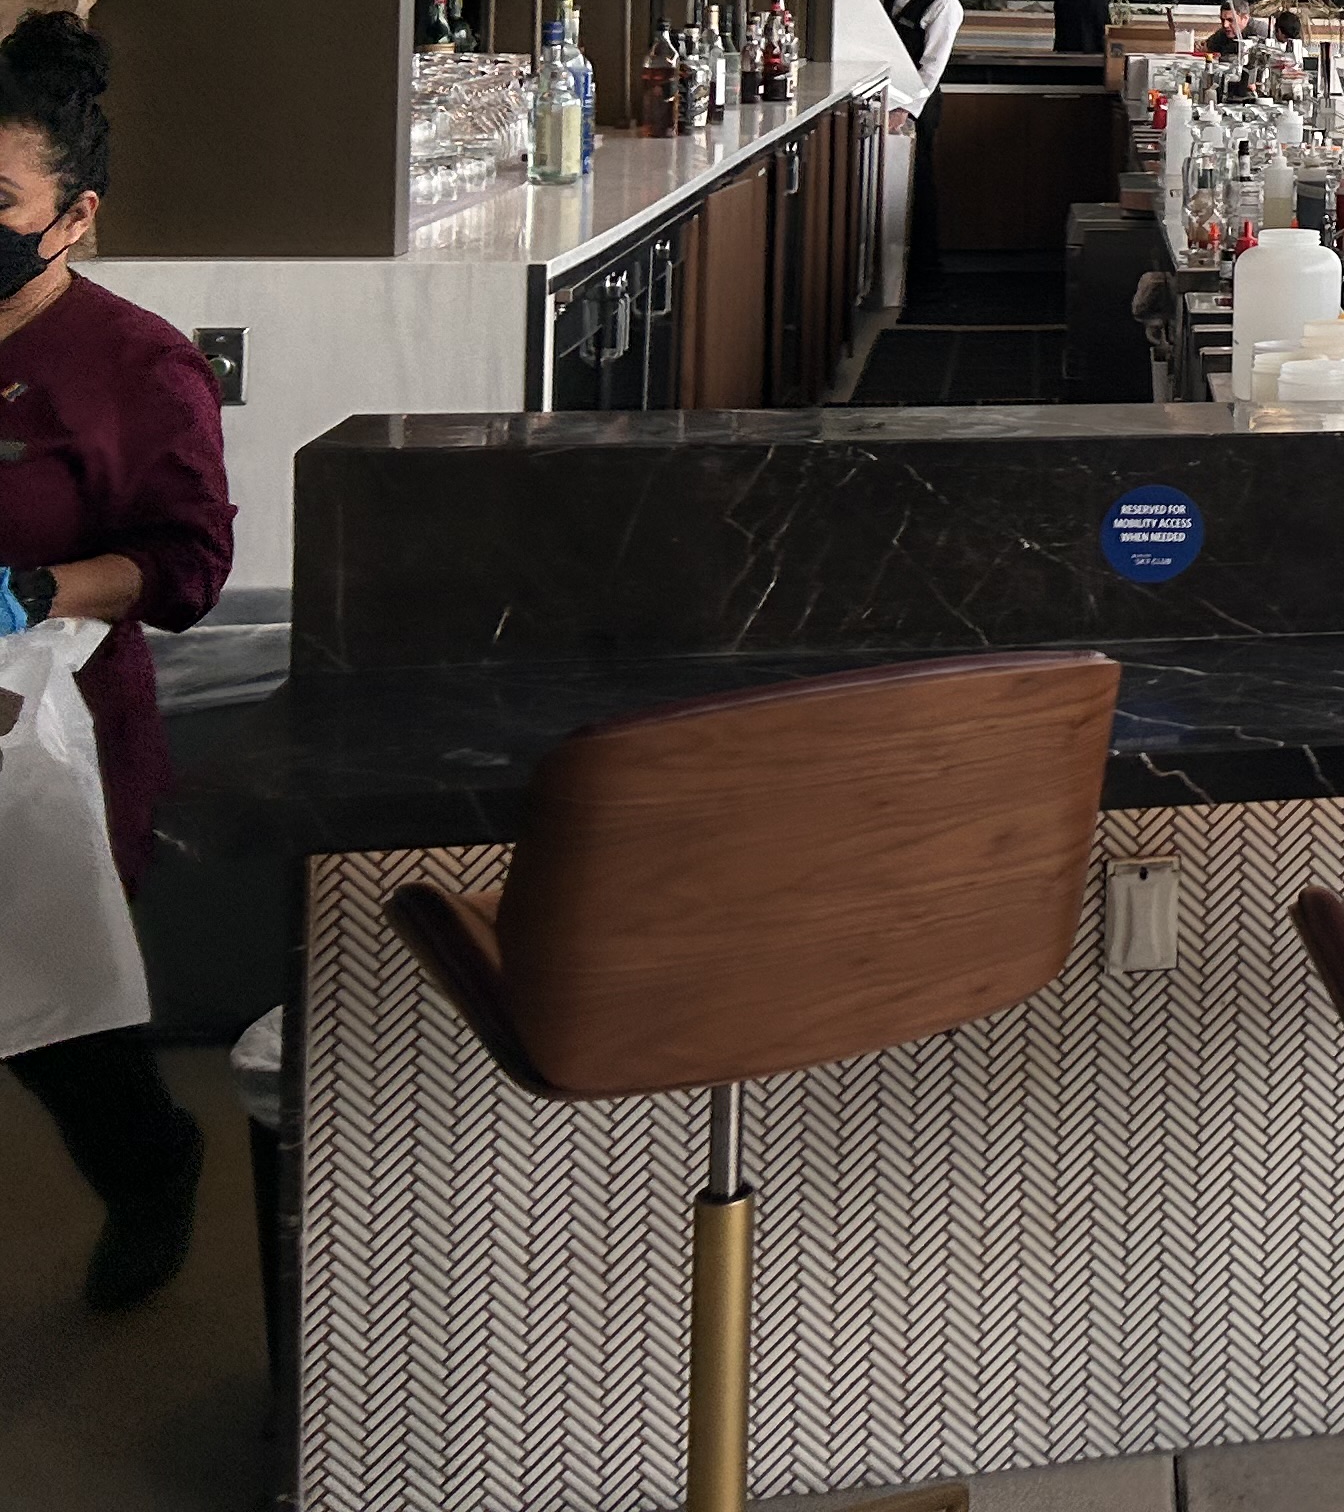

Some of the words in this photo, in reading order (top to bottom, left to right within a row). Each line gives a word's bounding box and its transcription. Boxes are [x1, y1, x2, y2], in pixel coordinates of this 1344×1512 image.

[1120, 504, 1167, 515] RESERVED
[1167, 504, 1187, 515] FOR
[1113, 518, 1158, 529] MOBILITY
[1158, 518, 1193, 529] ACCESS
[1120, 532, 1149, 542] WHEN
[1149, 532, 1187, 542] NEEDED
